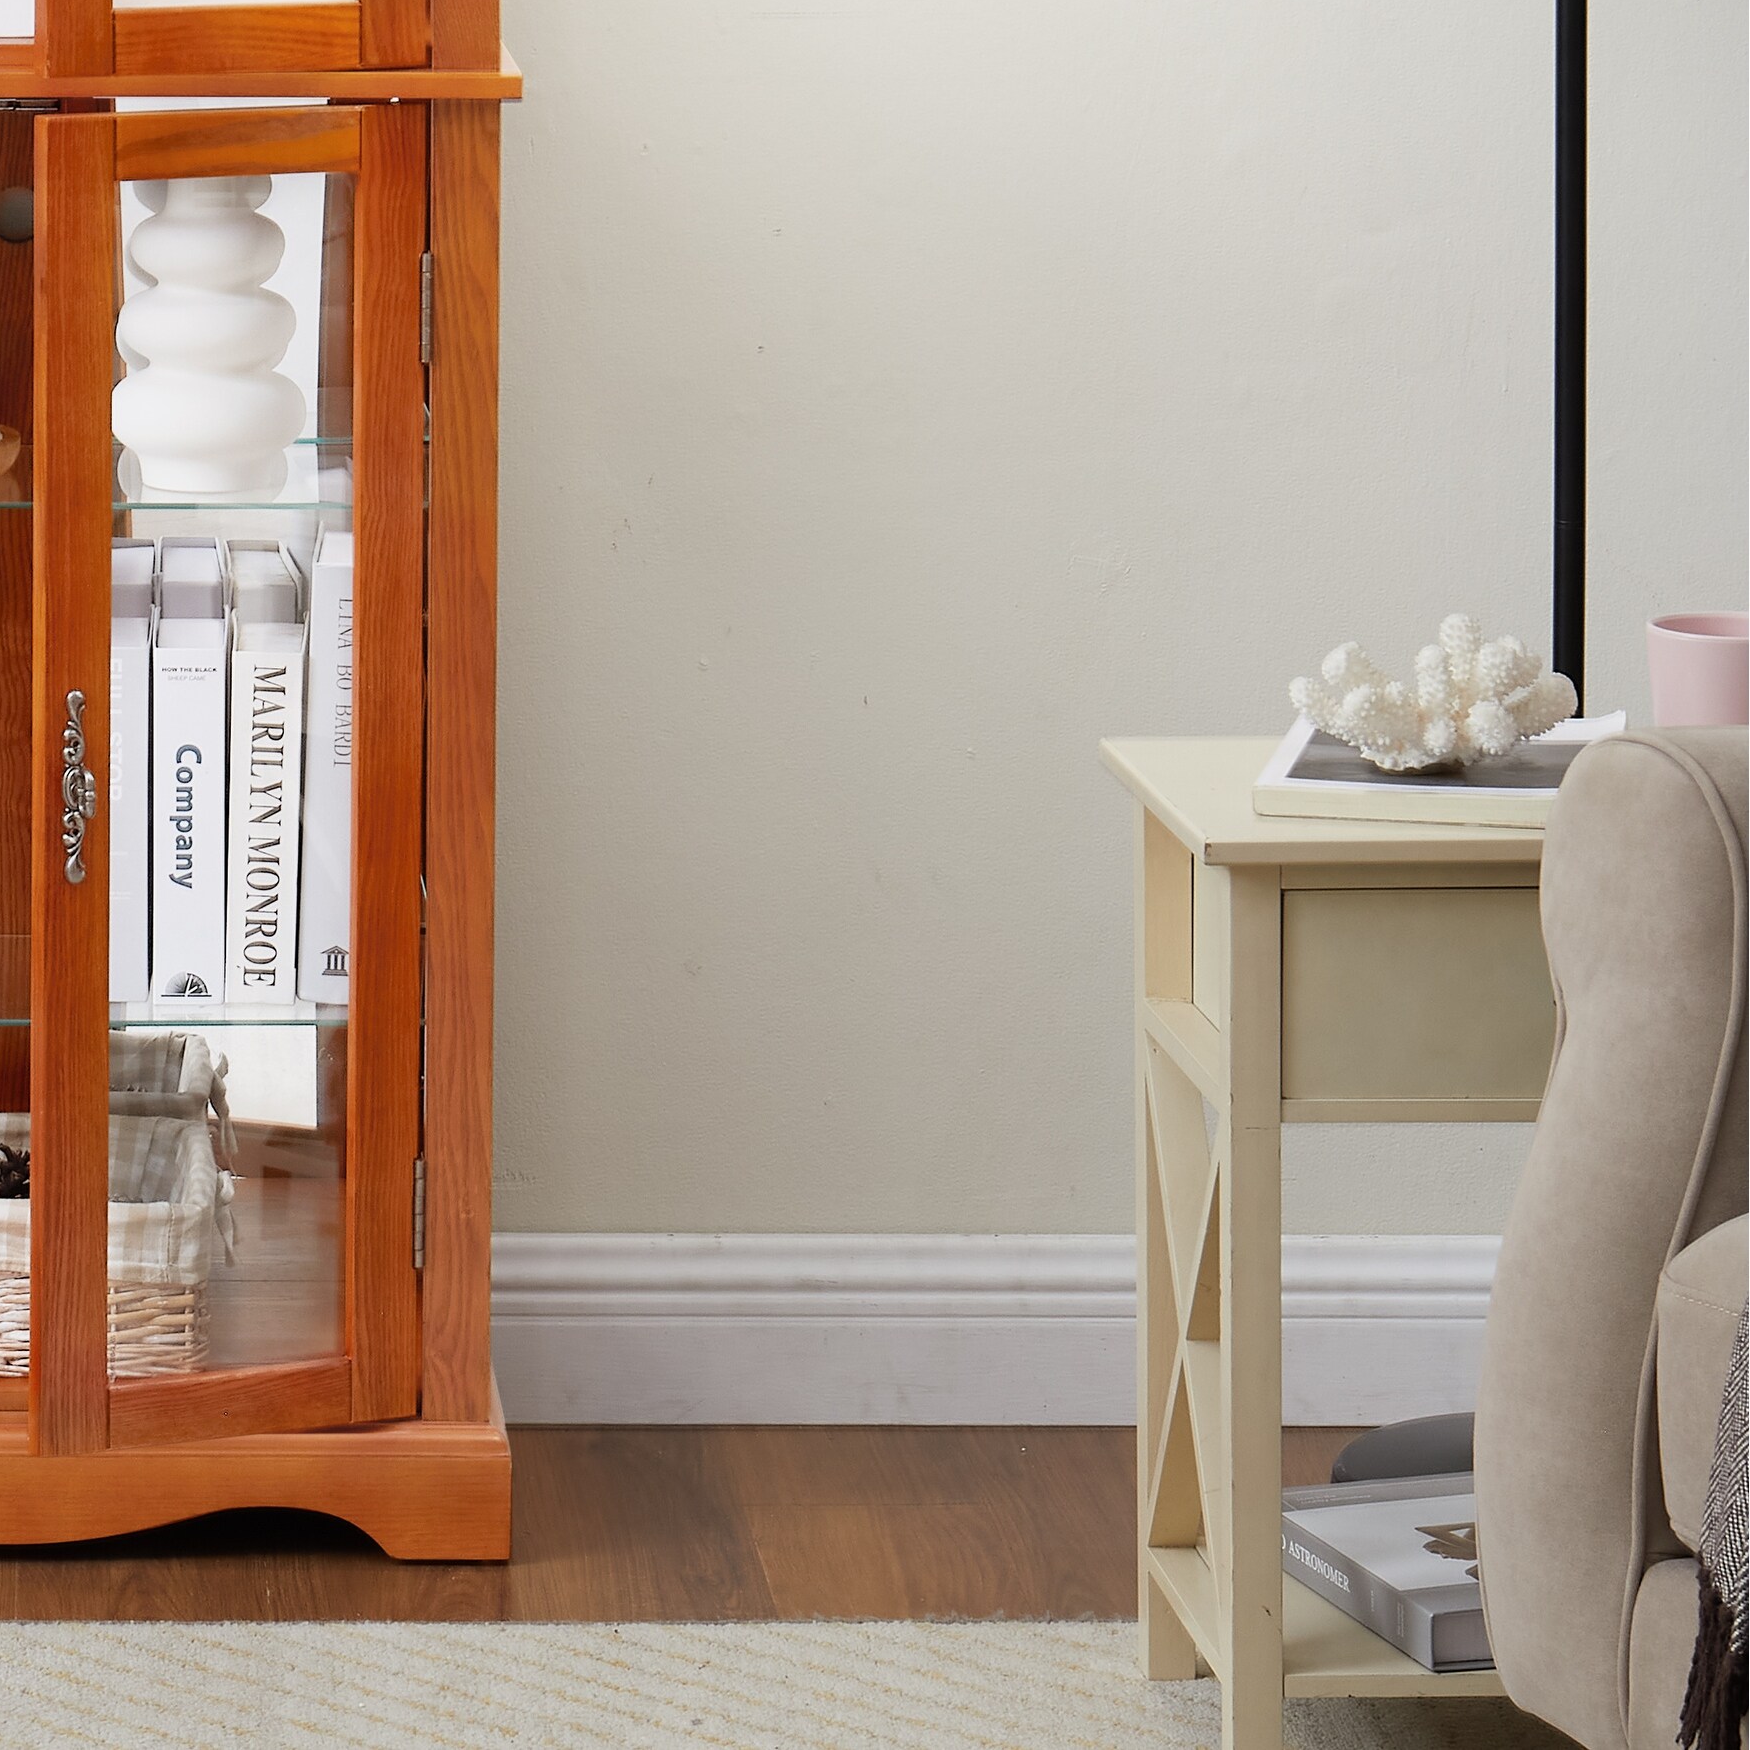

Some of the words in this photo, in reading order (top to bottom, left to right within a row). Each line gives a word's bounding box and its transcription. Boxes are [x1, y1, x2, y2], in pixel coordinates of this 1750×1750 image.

[338, 598, 353, 649] LINA
[249, 665, 288, 827] MARILYN
[333, 704, 353, 767] BARDI
[169, 744, 202, 890] Company
[243, 836, 282, 988] MONROE
[1289, 1541, 1351, 1593] ASTRONOMER
